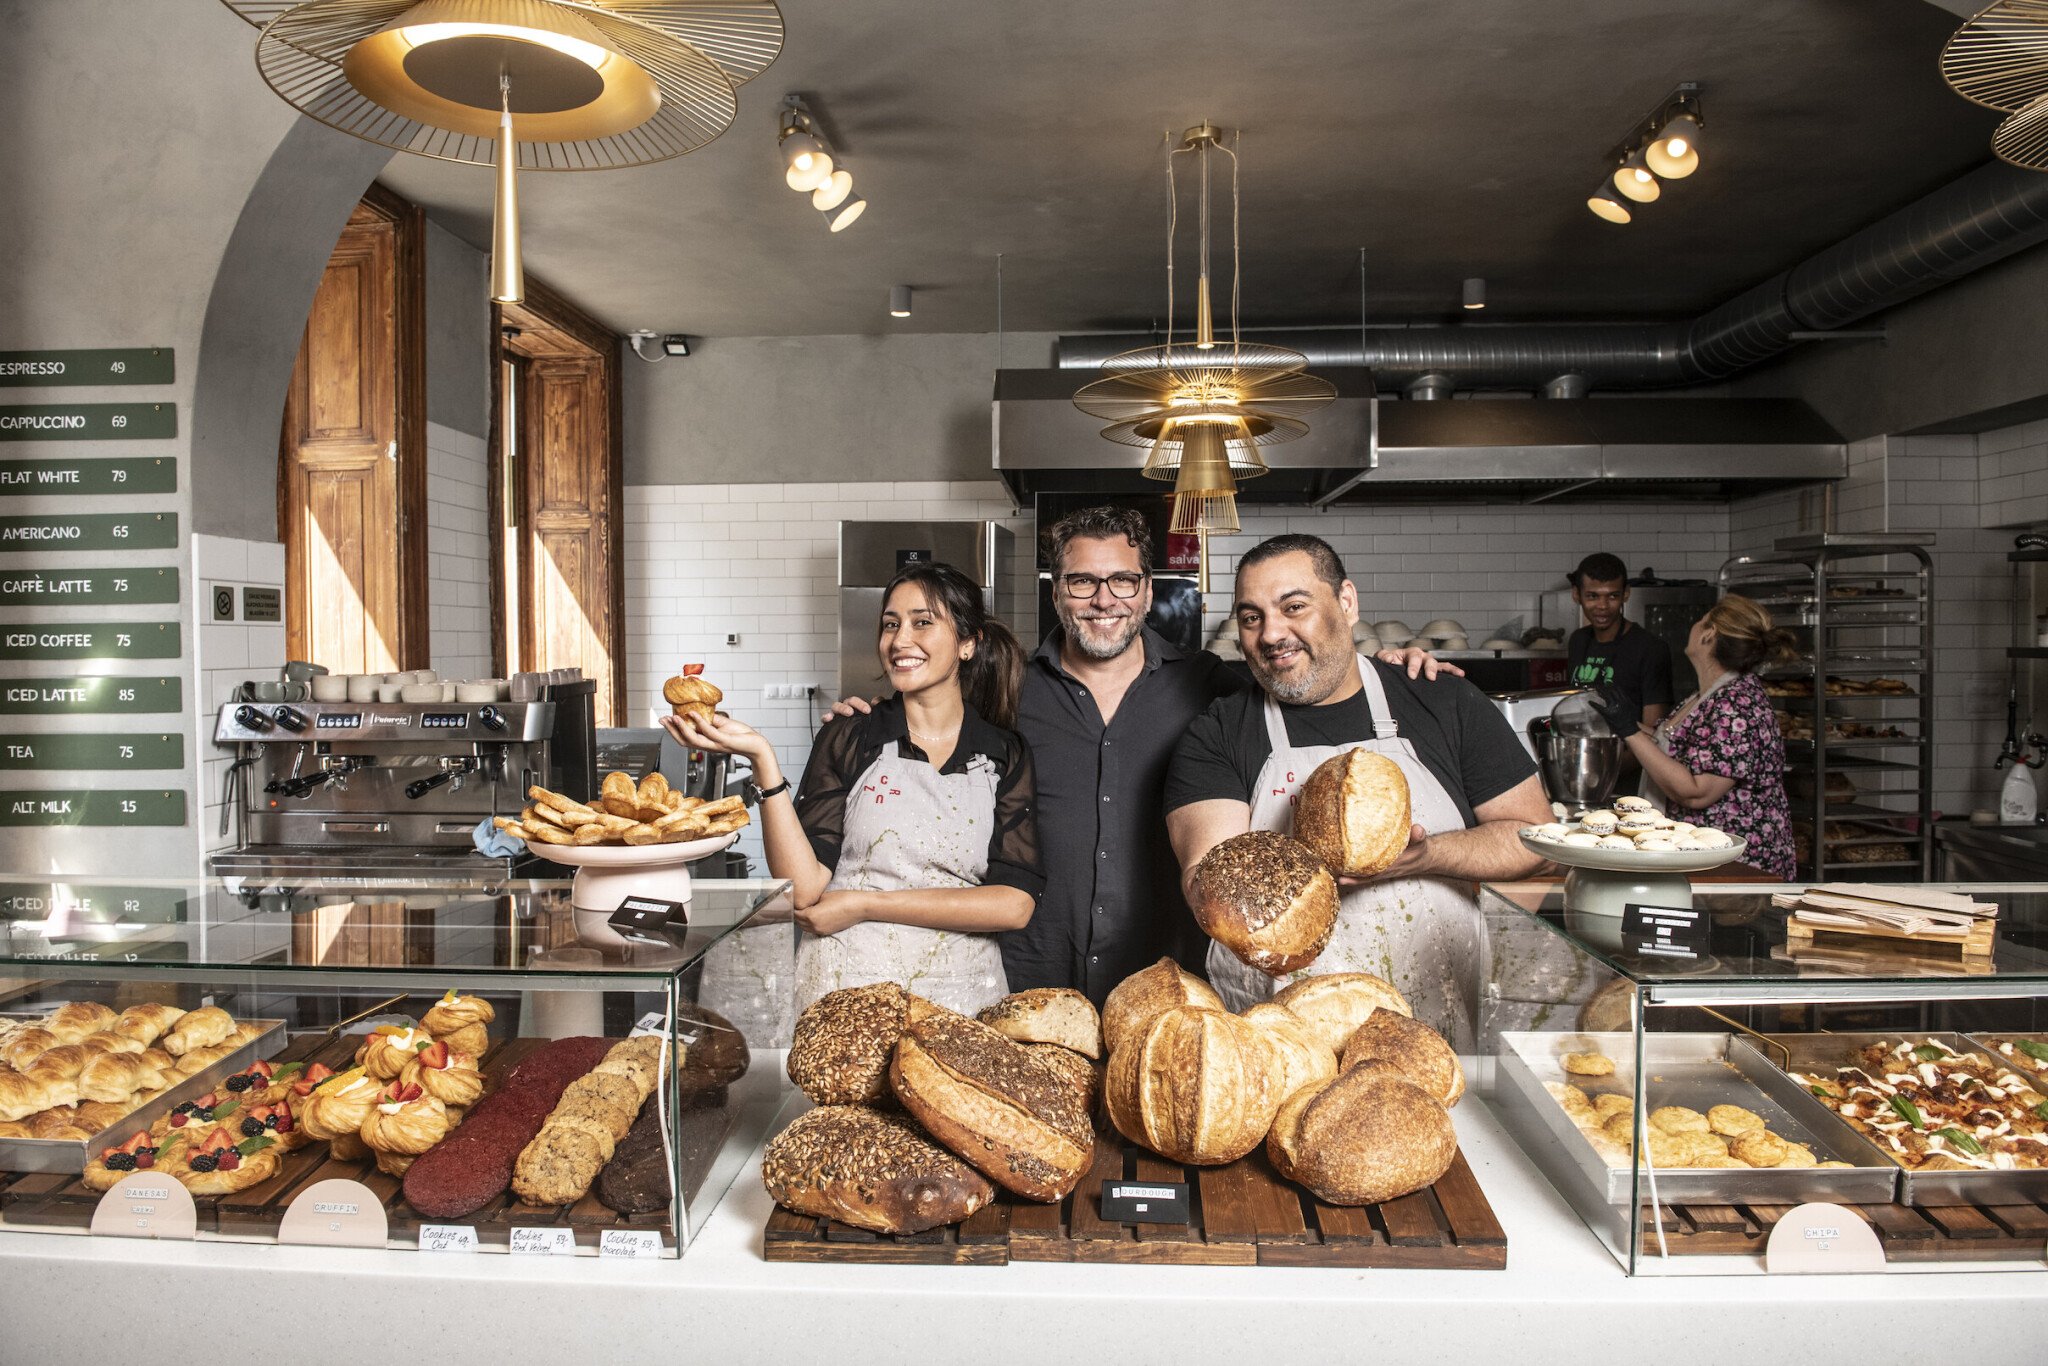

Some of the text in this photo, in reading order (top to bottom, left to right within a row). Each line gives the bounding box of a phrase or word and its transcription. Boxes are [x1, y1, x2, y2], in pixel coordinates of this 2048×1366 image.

[0, 361, 126, 375] ESPRESSO 49
[0, 415, 128, 429] CAPPUCCINO 69
[1, 469, 127, 484] FLAT WHITE 79
[2, 524, 129, 540] AMERICANO 65
[3, 573, 129, 593] CAFFÈ LATTE 75
[6, 633, 132, 648] ICED COFFEE 75
[7, 688, 135, 702] ICED LATTE 85
[7, 745, 134, 759] TEA 75
[12, 799, 137, 814] ALT. MILK 15
[126, 1189, 168, 1198] DANESAS
[1112, 1187, 1175, 1199] SOURDOUGH
[314, 1203, 358, 1213] CRUFFIN
[422, 1227, 457, 1240] Cookies
[512, 1229, 543, 1241] Cookies
[606, 1231, 638, 1246] Cookies
[1805, 1228, 1839, 1238] CHIPA
[431, 1240, 448, 1250] Oat
